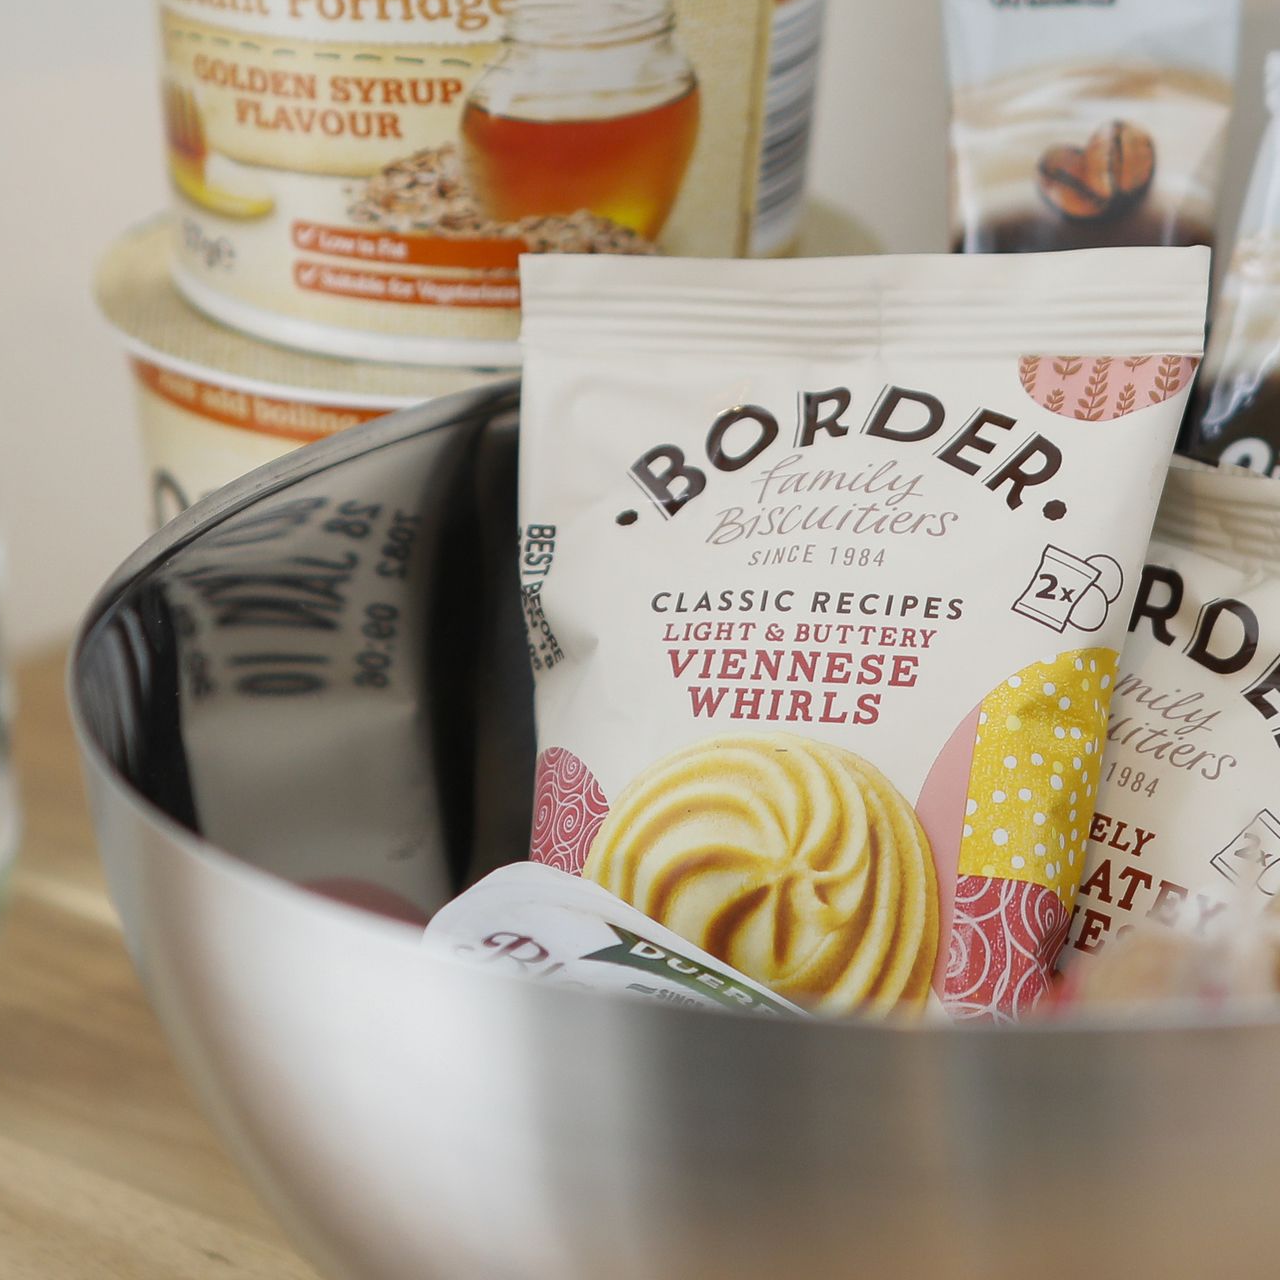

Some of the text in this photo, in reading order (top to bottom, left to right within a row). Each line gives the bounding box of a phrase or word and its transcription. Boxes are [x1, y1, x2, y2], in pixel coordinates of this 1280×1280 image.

[194, 54, 465, 110] GOLDEN SYRUP
[235, 101, 405, 141] FLAVOUR
[626, 382, 1065, 520] BORDER
[522, 523, 557, 577] BEST
[747, 542, 887, 569] SINCE 1984
[650, 589, 966, 622] CLASSIC RECIPES
[1032, 572, 1076, 606] 2x
[661, 620, 939, 651] LIGHT & BUTTERY
[665, 647, 921, 689] VIENNESE
[684, 684, 883, 727] WHIRLS
[1105, 761, 1160, 799] 1984
